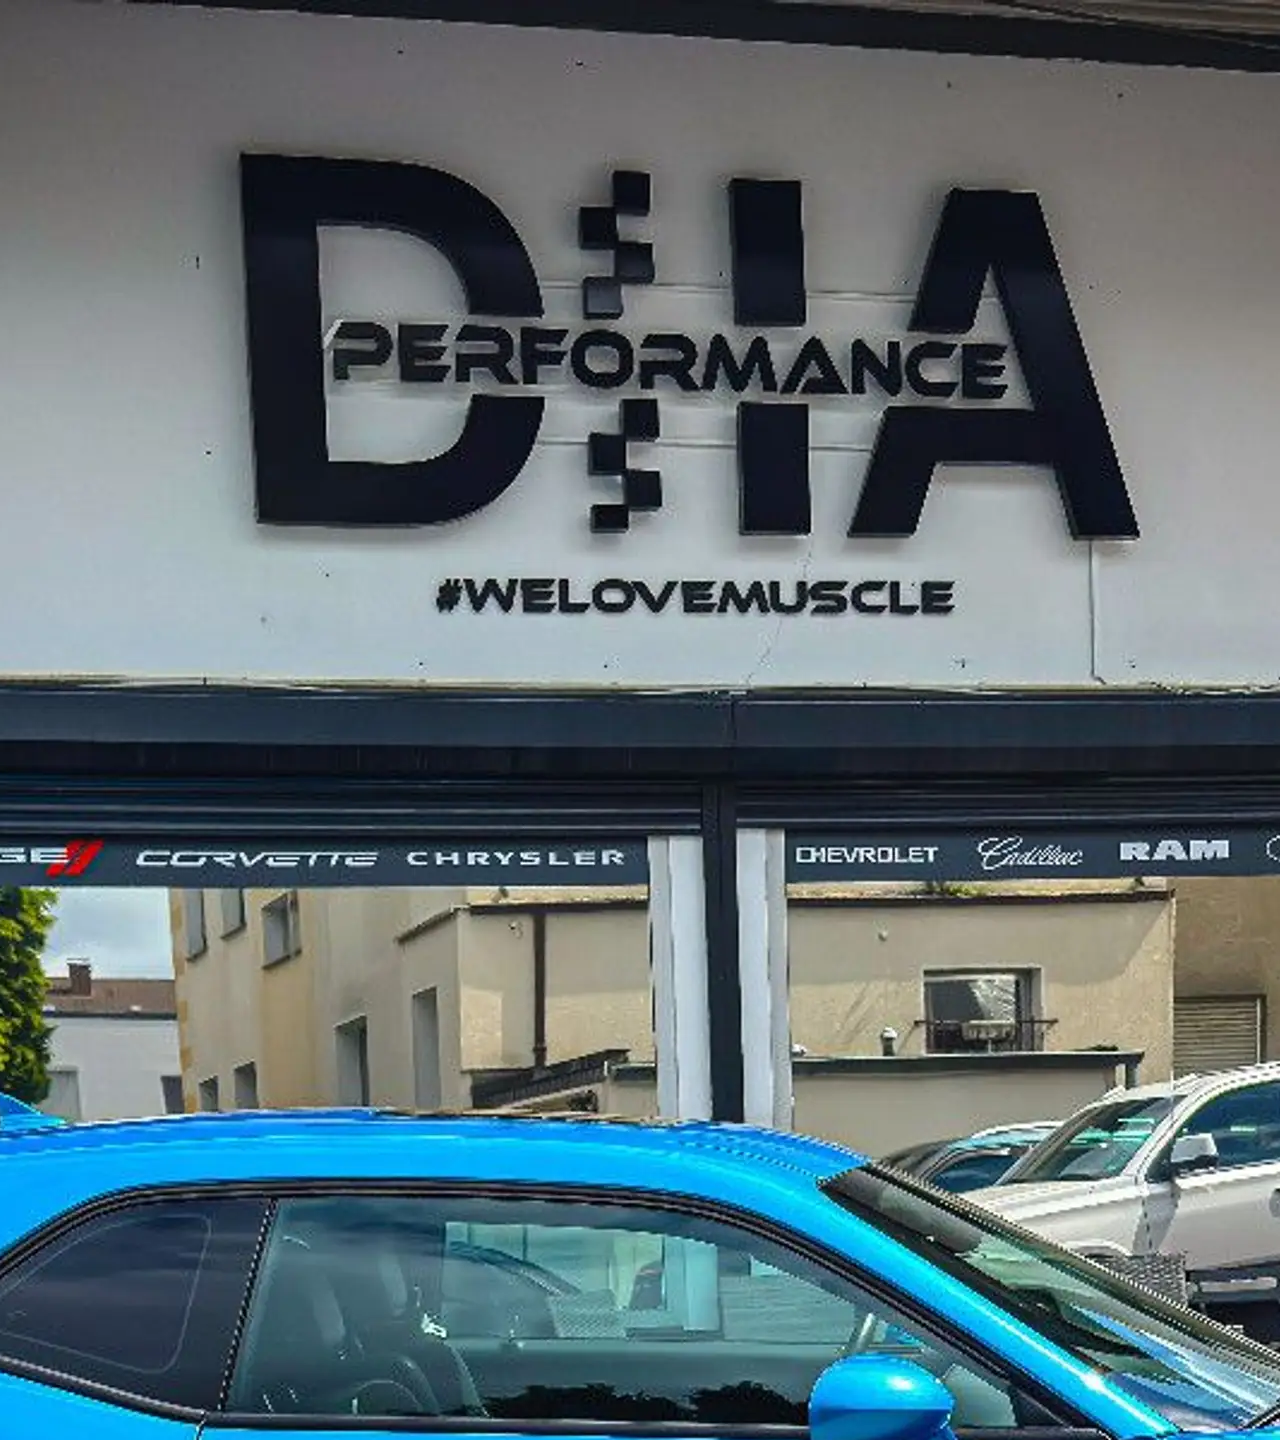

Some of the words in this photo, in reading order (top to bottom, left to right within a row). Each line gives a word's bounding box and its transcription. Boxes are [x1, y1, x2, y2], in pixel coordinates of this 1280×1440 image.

[330, 320, 1010, 400] PERFORMANCE
[435, 577, 956, 616] #WELOVEMUSCLE
[134, 849, 380, 868] CORVETTE
[406, 848, 626, 867] CHRYSLER
[795, 845, 939, 864] CHEVROLET
[976, 835, 1084, 871] Cadillac
[1118, 838, 1231, 862] RAM
